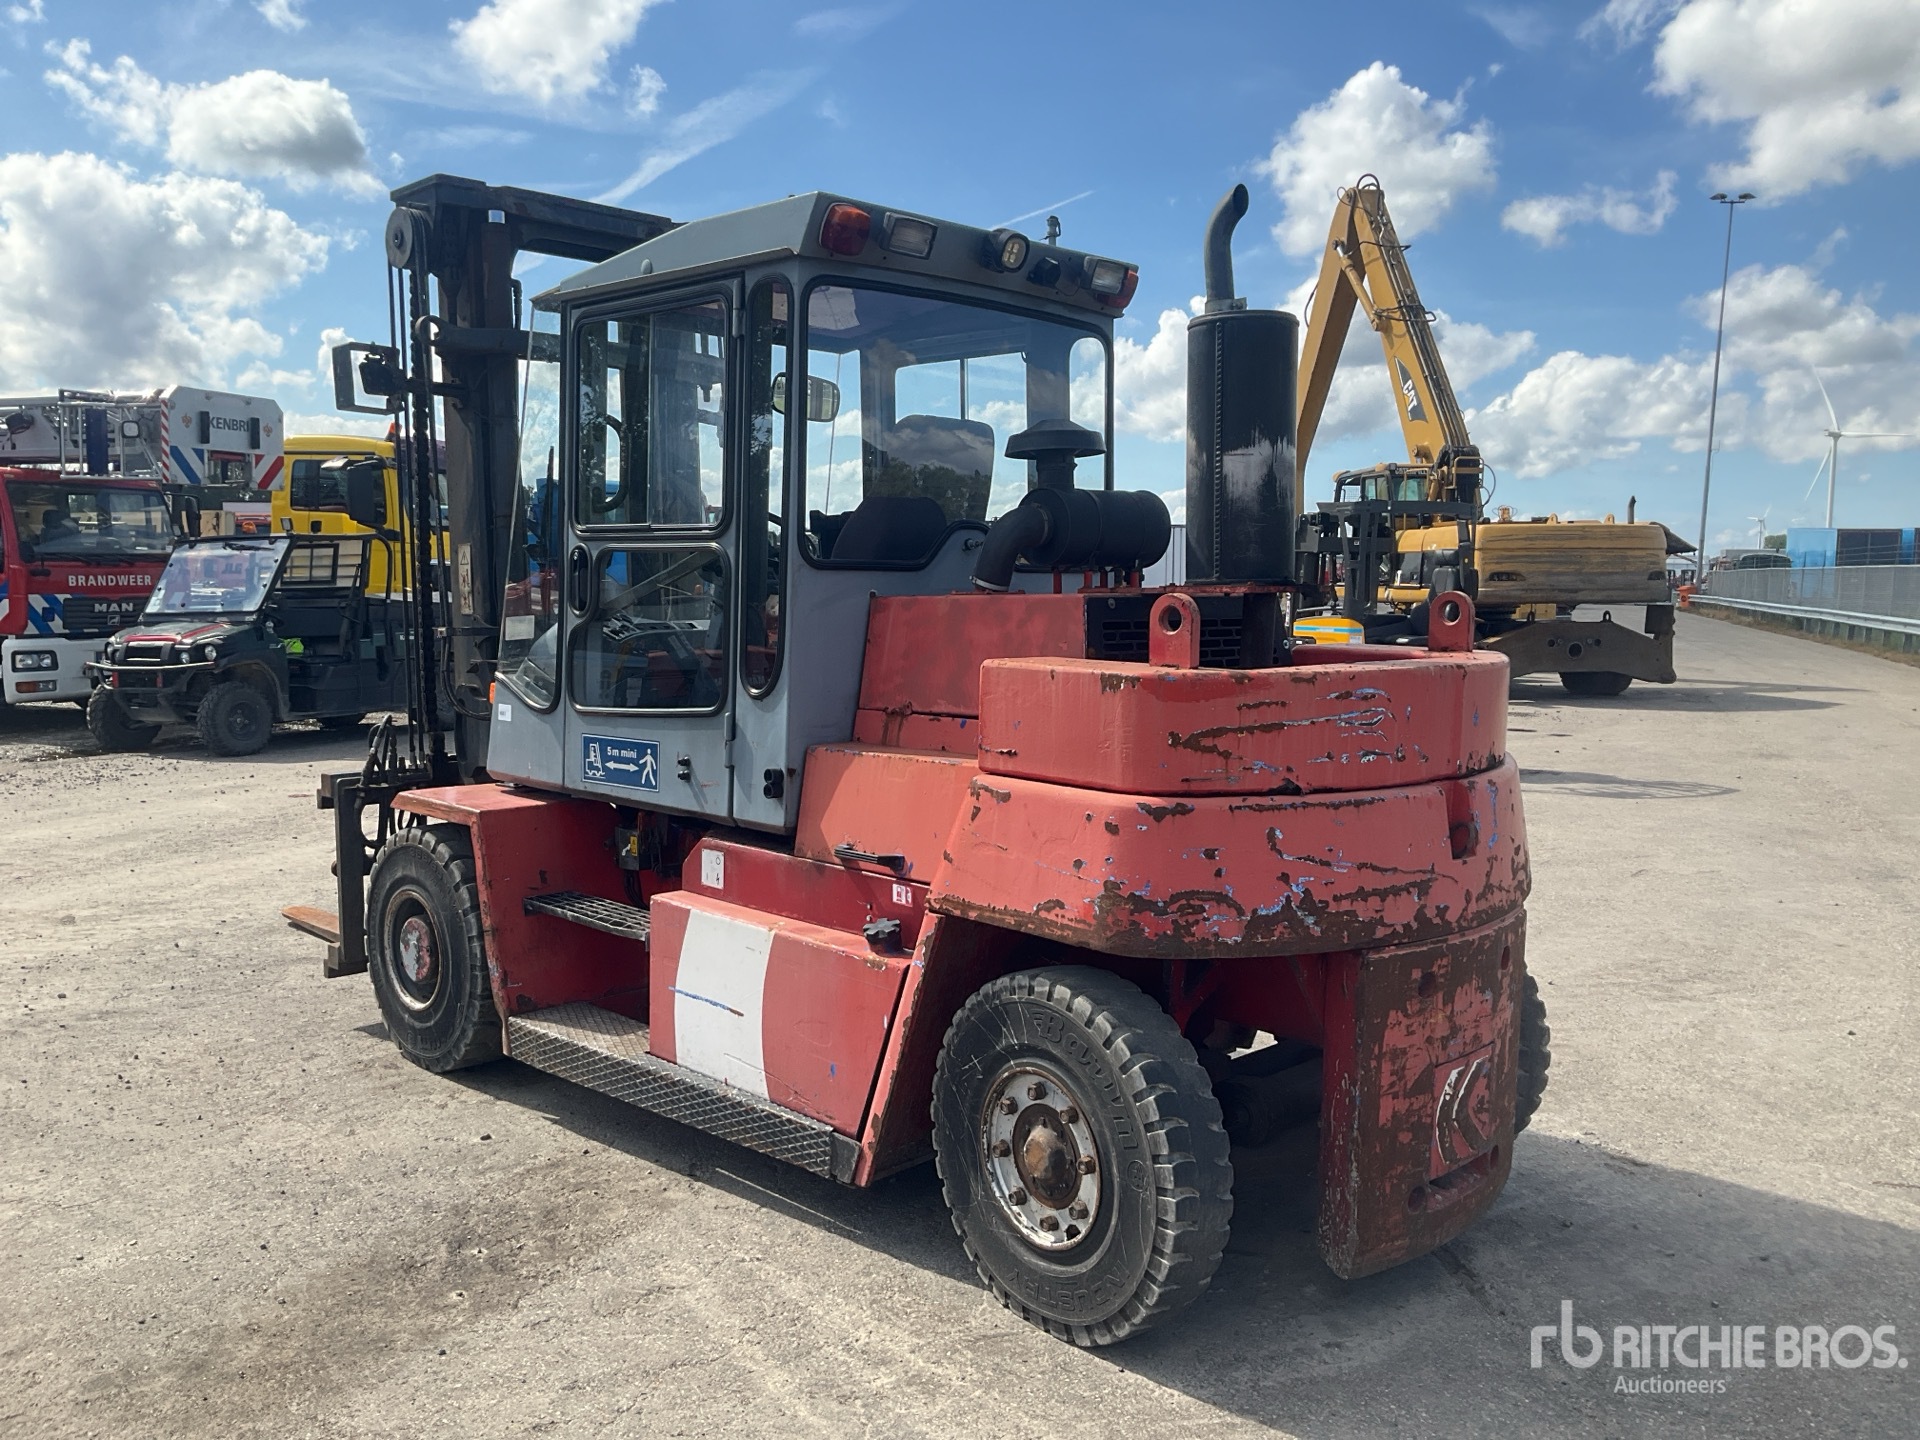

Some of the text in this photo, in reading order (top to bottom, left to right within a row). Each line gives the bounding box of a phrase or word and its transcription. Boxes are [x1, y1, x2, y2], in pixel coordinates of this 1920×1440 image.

[1403, 379, 1417, 411] CAT
[68, 574, 152, 587] BRANDWEER
[94, 602, 134, 613] MAN
[621, 748, 637, 758] mini
